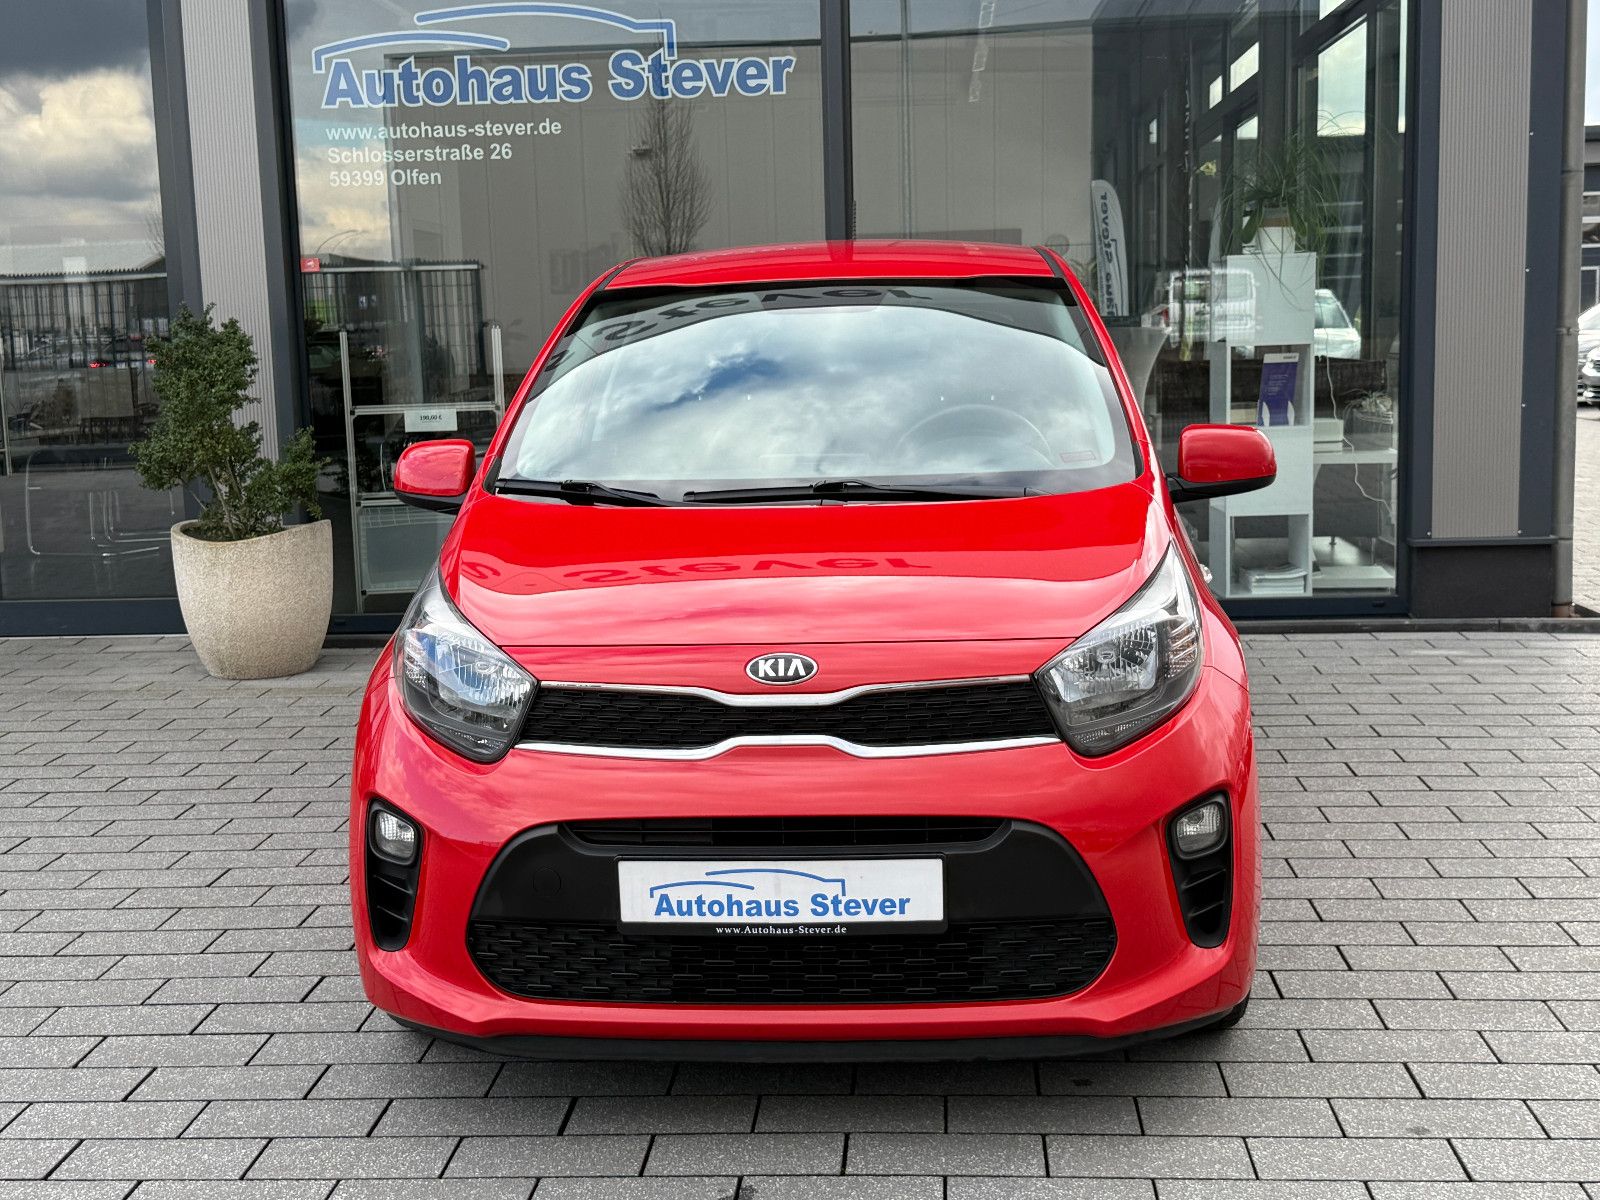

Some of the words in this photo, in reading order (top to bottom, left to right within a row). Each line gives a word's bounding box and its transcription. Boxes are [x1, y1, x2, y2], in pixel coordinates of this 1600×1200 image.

[321, 54, 593, 109] Autohaus
[608, 47, 796, 100] Stever
[325, 118, 562, 141] www.autohaus-stever.de
[327, 143, 484, 165] Schlosserstraße
[489, 143, 513, 161] 26
[329, 169, 385, 188] 59399
[390, 167, 442, 186] Olfen
[758, 658, 806, 677] KIA
[654, 894, 799, 917] Autohaus
[810, 892, 911, 916] Stever
[715, 924, 847, 935] www.Autohaus-Stever.de
